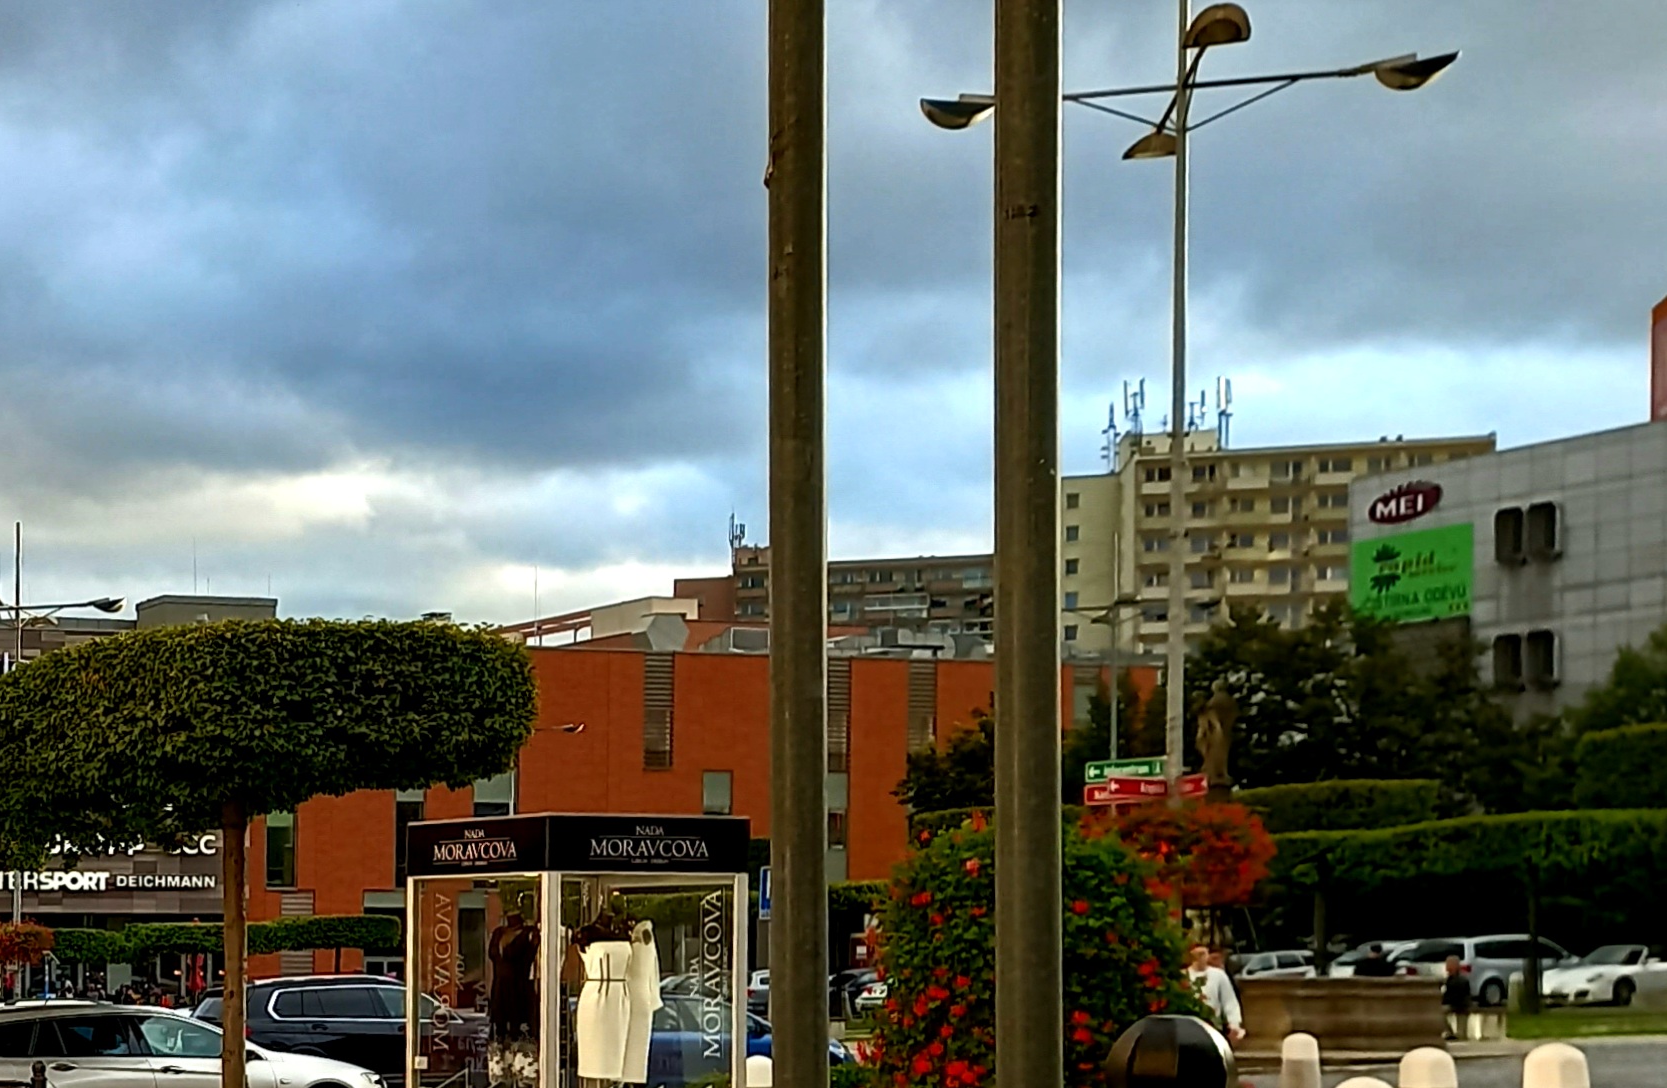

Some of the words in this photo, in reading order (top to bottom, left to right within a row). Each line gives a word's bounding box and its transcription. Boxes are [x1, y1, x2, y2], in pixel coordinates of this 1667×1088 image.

[1375, 494, 1424, 519] MEI
[636, 826, 664, 836] NADA
[433, 841, 517, 861] MORAVCOVA
[590, 839, 709, 857] MORAVCOVA
[116, 875, 216, 888] DEICHMANN
[703, 889, 722, 1057] MORAVCOVA
